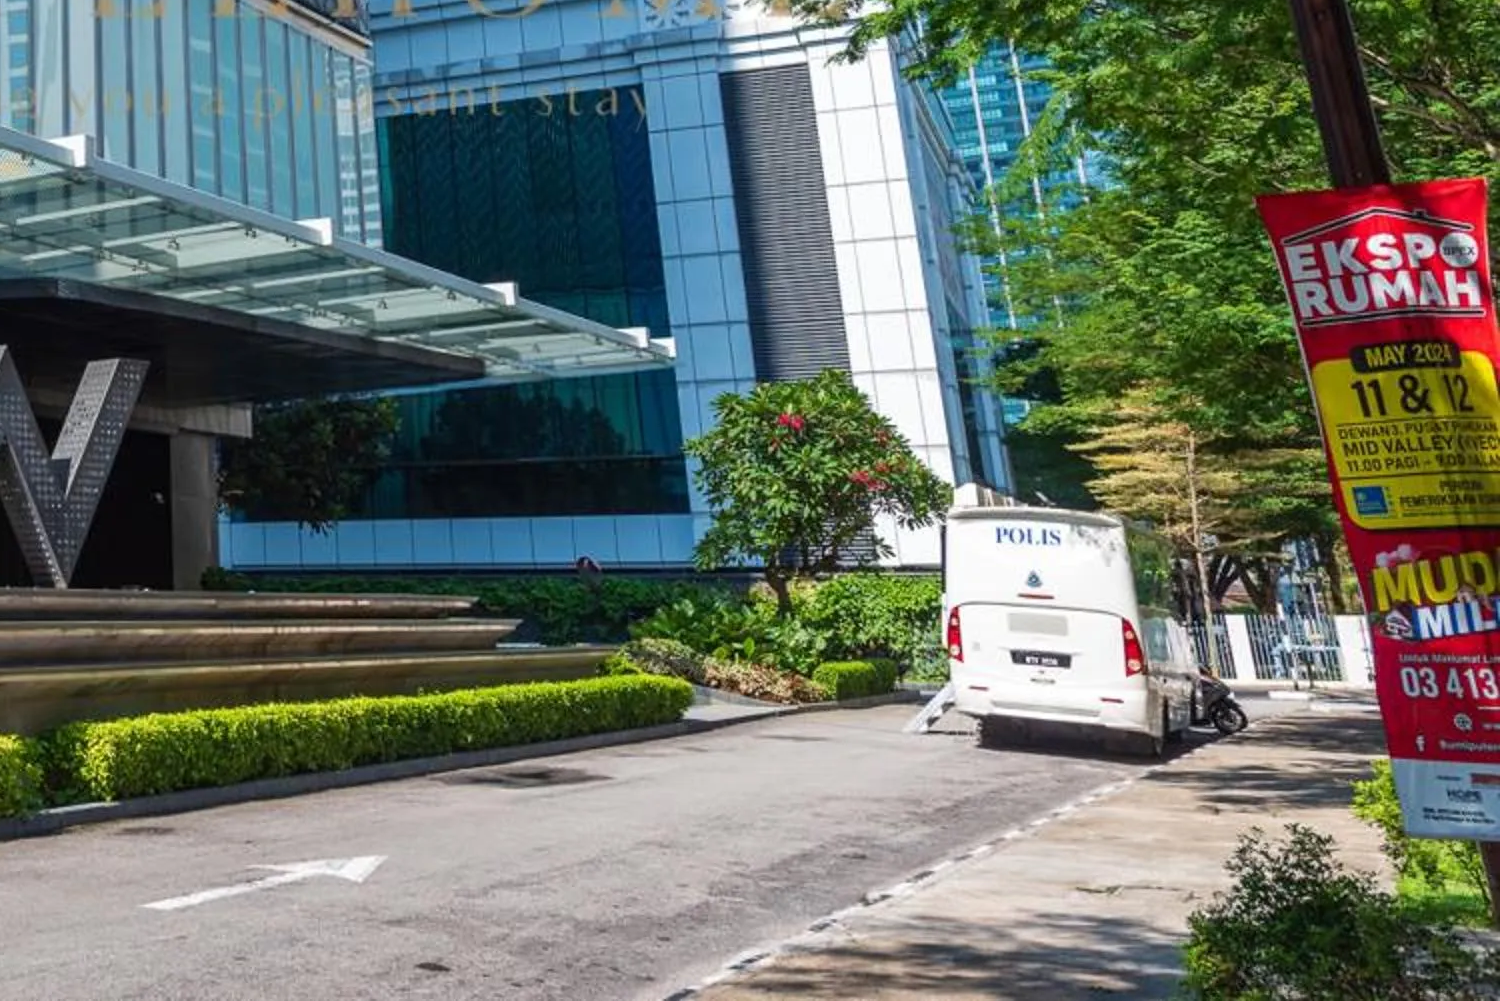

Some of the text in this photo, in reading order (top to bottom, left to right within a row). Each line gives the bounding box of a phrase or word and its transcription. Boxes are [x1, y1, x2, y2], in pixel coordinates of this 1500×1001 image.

[1293, 270, 1481, 317] RUMAH
[1364, 343, 1453, 367] MAY 2024
[1351, 374, 1474, 418] 11 & 12
[1341, 440, 1380, 457] MID
[1381, 435, 1453, 454] VALLEY
[995, 526, 1062, 546] POLIS
[1373, 547, 1500, 611] MUD
[1417, 599, 1500, 639] MIL
[1401, 667, 1500, 699] 03 413
